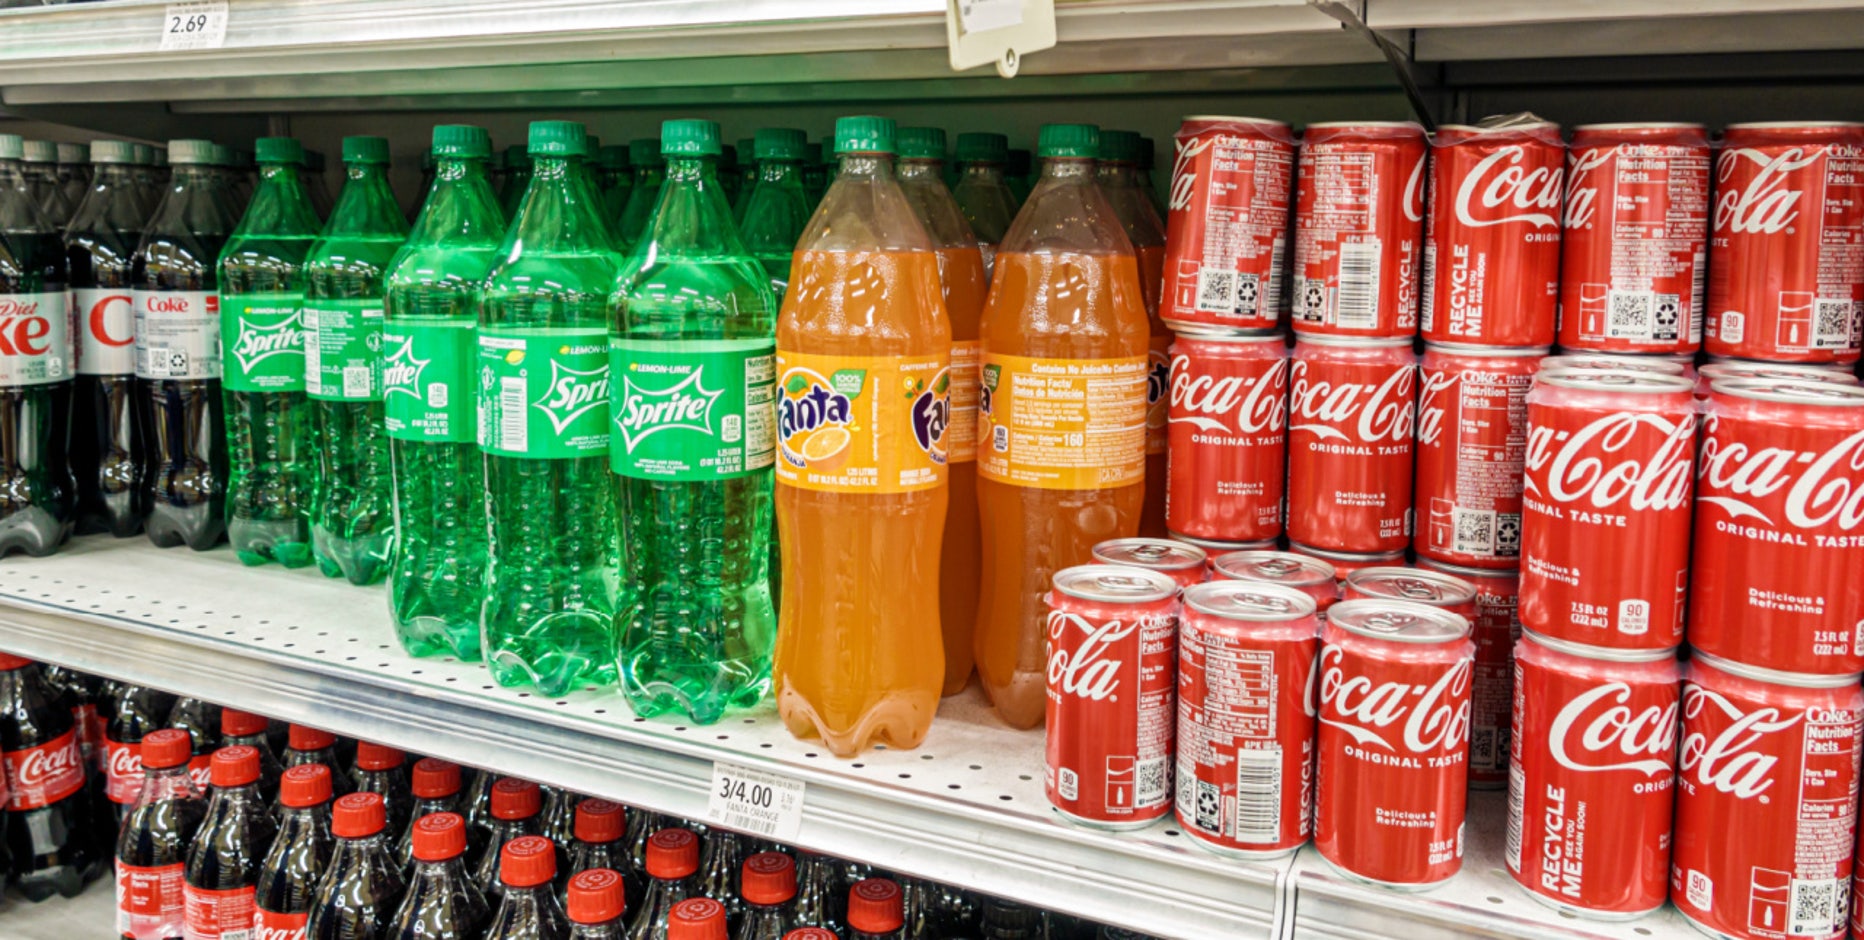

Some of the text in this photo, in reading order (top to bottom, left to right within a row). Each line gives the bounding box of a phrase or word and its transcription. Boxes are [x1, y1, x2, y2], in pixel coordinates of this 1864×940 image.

[170, 14, 207, 33] 2.69
[1215, 149, 1255, 160] Nutrition
[1214, 159, 1239, 170] Facts
[1619, 158, 1667, 170] Nutrition
[1619, 170, 1649, 183] Facts
[1828, 172, 1855, 184] Facts
[1455, 145, 1564, 224] Coca
[1398, 239, 1412, 328] RECYCLE
[1450, 245, 1468, 336] RECYCLE
[3, 301, 38, 316] Diet
[147, 296, 189, 313] Coke
[1466, 305, 1482, 337] ME
[1726, 315, 1738, 328] 90
[637, 363, 692, 374] LEMON-LIME
[1032, 363, 1066, 374] Contains
[1068, 365, 1079, 374] No
[1013, 375, 1046, 387] Nutrition
[1461, 370, 1499, 384] Coke
[1013, 387, 1035, 397] Datos
[1036, 387, 1046, 397] de
[1463, 385, 1507, 397] Nutrition
[1463, 395, 1490, 408] Facts
[622, 392, 708, 431] Sprite
[1063, 433, 1084, 447] 160
[1191, 434, 1283, 446] ORIGINAL TASTE
[1309, 442, 1409, 456] ORIGINAL TASTE
[1525, 412, 1697, 511] a-Cola
[1217, 481, 1258, 490] Delicious
[1217, 487, 1264, 496] Refreshing
[1335, 491, 1379, 500] Delicious
[1335, 498, 1386, 507] Refreshing
[1570, 510, 1627, 527] TASTE
[1716, 519, 1864, 548] ORIGINAL TASTE
[1528, 555, 1581, 577] Delicious &
[1528, 564, 1579, 587] Refreshing
[1749, 587, 1825, 605] Delicious &
[1571, 602, 1609, 616] 7.5 FL OZ
[1627, 603, 1642, 617] 90
[1749, 597, 1823, 614] Refreshing
[1570, 613, 1609, 629] (222 mL)
[1814, 631, 1849, 642] 7.5 FL OZ
[1143, 640, 1164, 654] Facts
[1813, 642, 1848, 655] (222 mL)
[1805, 706, 1847, 723] Coke
[1549, 682, 1679, 773] Coca
[1807, 726, 1853, 740] Nutrition
[1807, 738, 1839, 752] Facts
[1344, 744, 1463, 769] ORIGINAL TASTE
[1062, 770, 1074, 786] 90
[720, 777, 773, 808] 3/4.00
[1300, 740, 1313, 837] RECYCLE
[726, 802, 779, 822] FANTA ORANGE
[1375, 806, 1427, 820] Delicious
[1803, 802, 1834, 813] Calories
[1375, 815, 1436, 828] Refreshing
[1575, 801, 1587, 860] AGAIN SOON!
[1541, 784, 1566, 892] RECYCLE
[1566, 819, 1575, 857] SEE YOU
[1562, 861, 1582, 898] ME
[1691, 875, 1706, 891] 90
